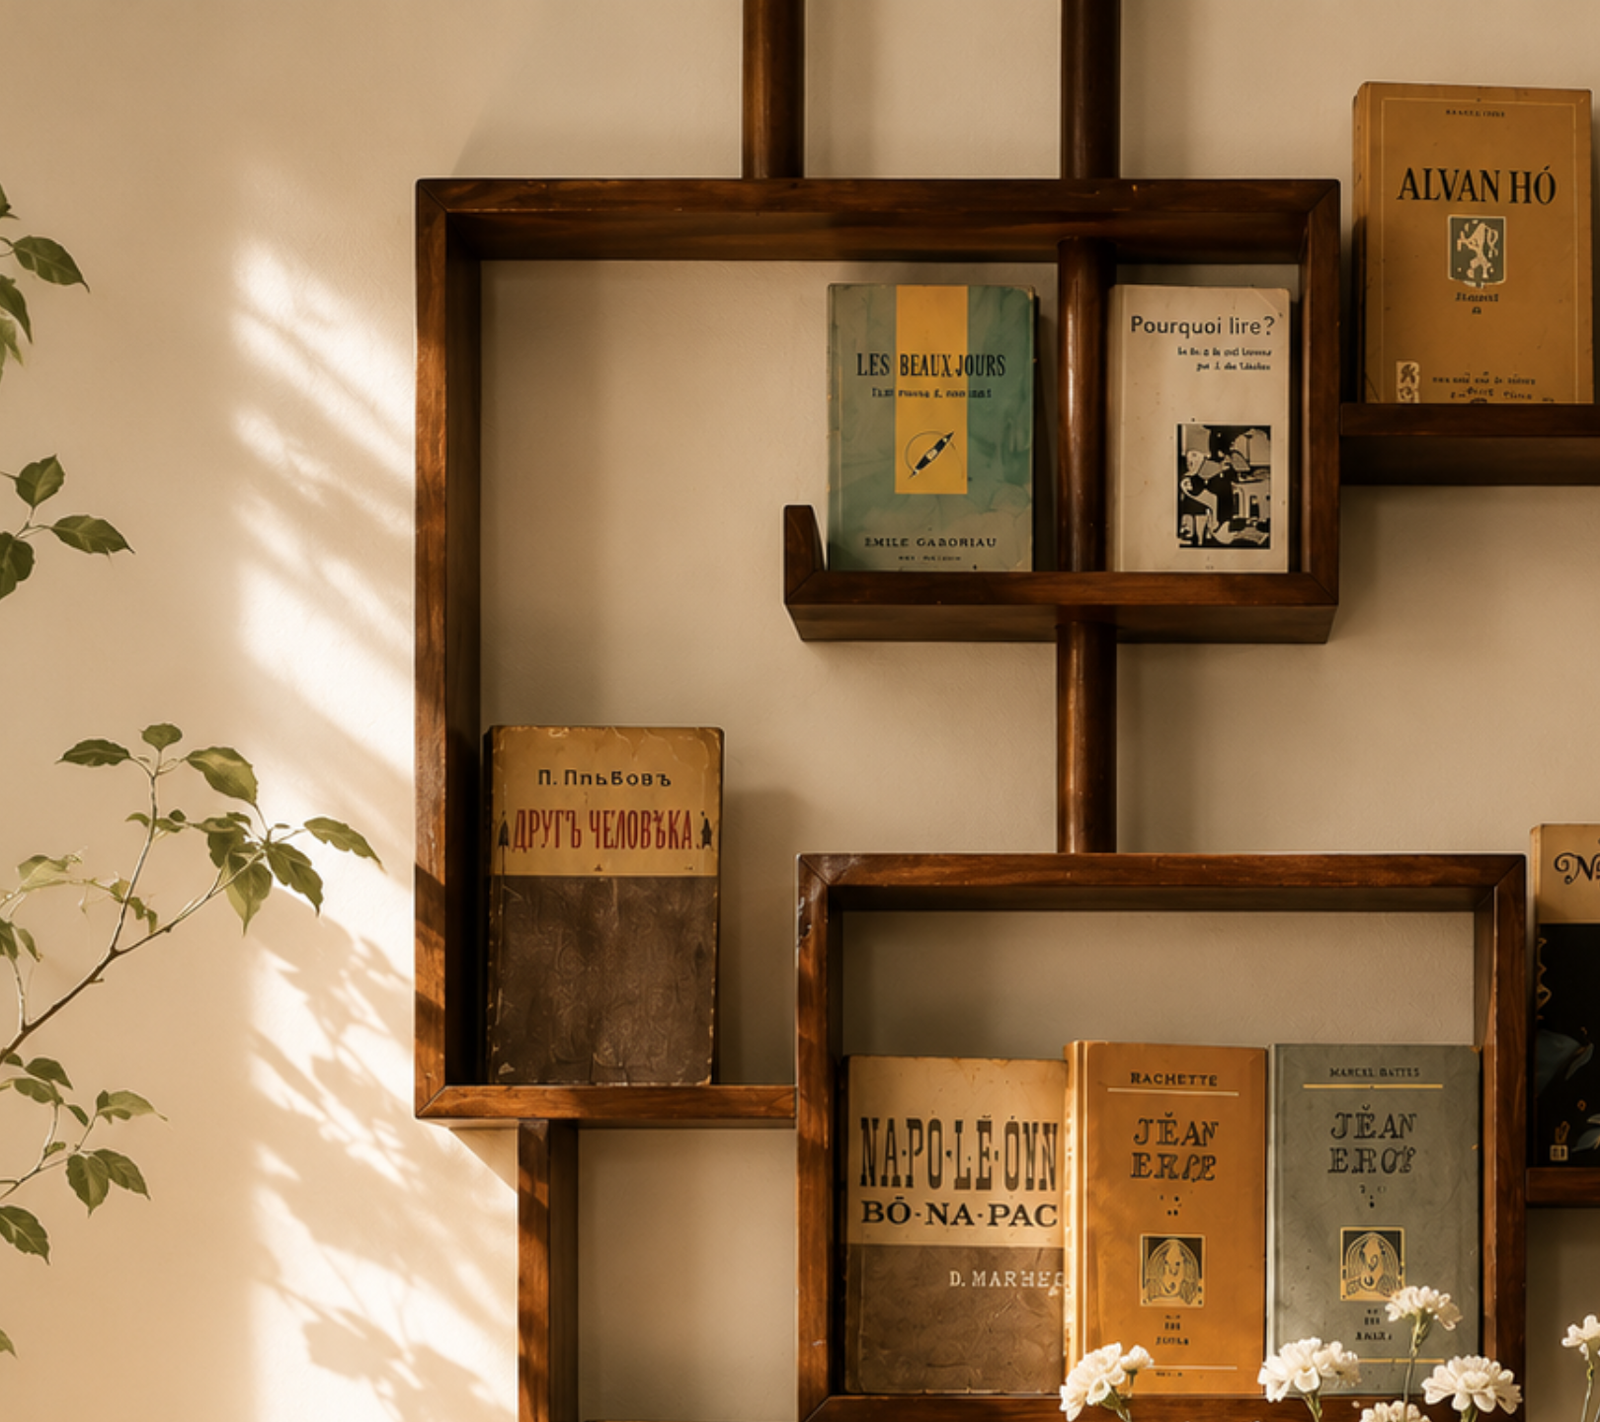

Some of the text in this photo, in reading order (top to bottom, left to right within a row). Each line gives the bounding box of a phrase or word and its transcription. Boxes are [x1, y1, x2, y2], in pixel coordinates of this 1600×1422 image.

[1396, 167, 1500, 203] ALVAN
[1130, 315, 1275, 339] Pourquoi lire?
[856, 353, 1006, 377] LES BEAUX JOURS
